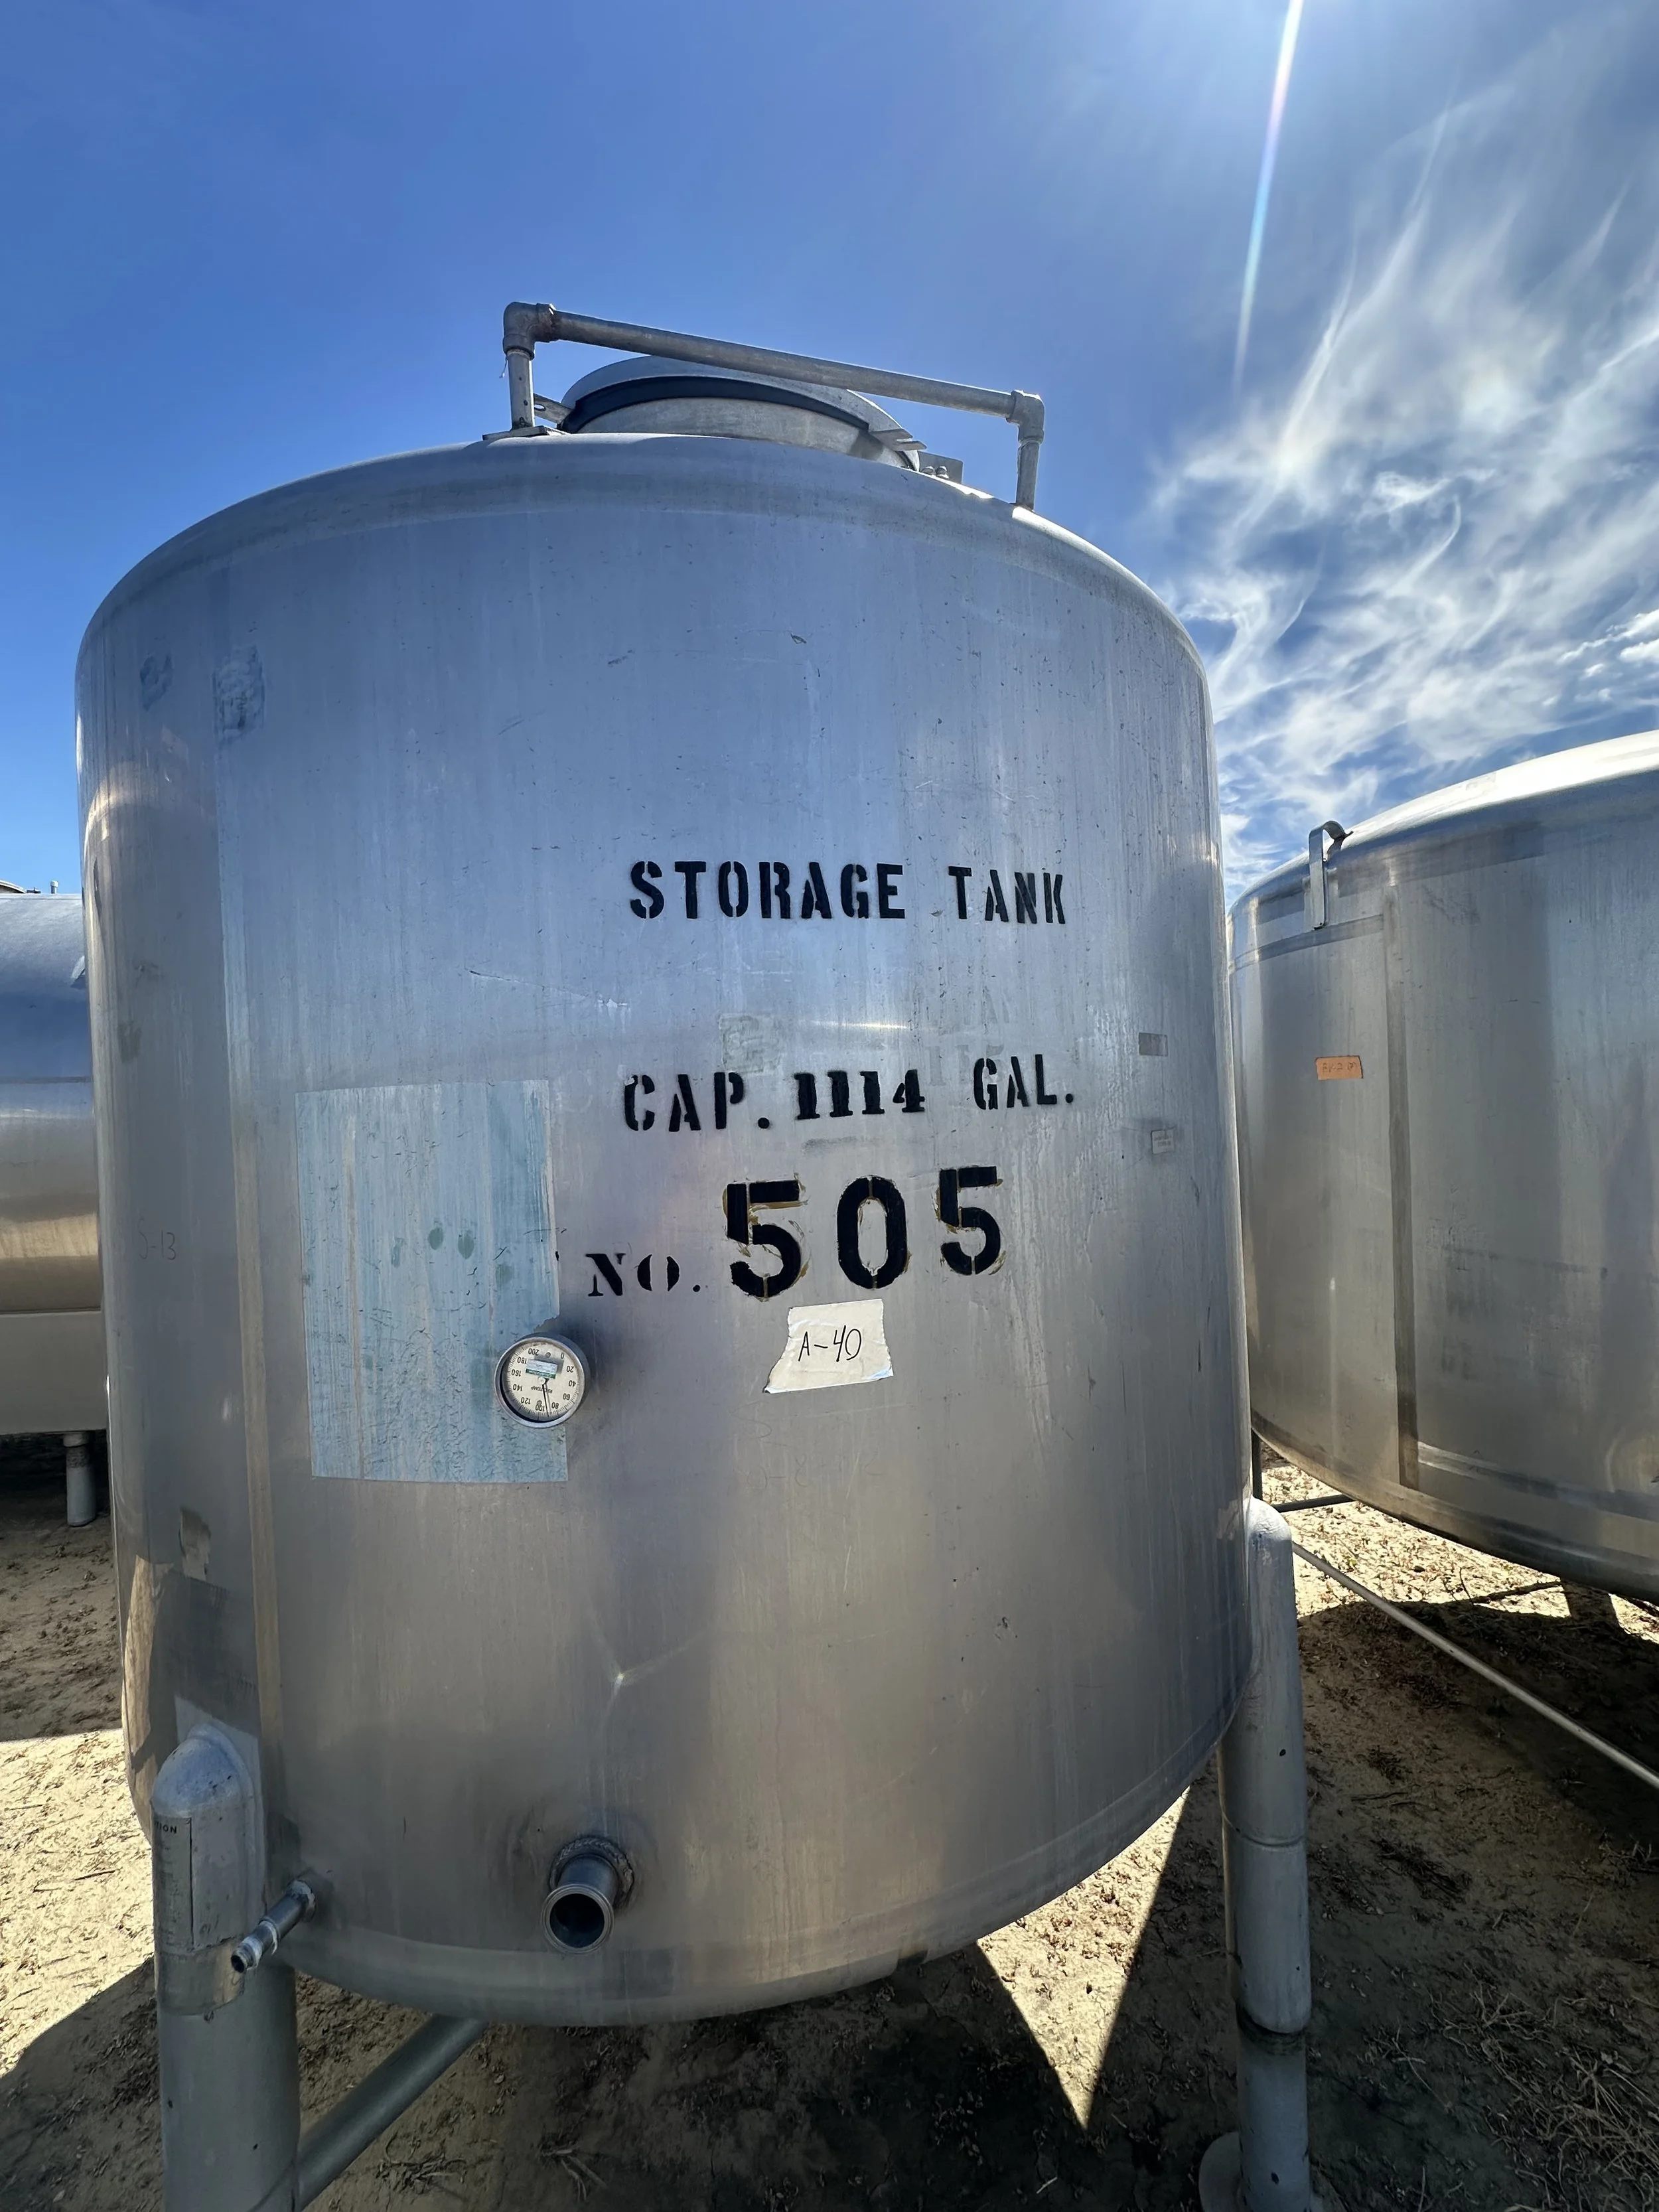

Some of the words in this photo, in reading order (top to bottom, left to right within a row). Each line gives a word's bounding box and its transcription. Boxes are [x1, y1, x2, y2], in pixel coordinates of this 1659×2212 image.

[629, 860, 906, 921] STORAGE
[948, 865, 1066, 924] TANK
[623, 1072, 770, 1132] CAP.
[794, 1069, 926, 1120] 1114
[972, 1054, 1074, 1110] GAL.
[585, 1252, 701, 1297] NO.
[727, 1165, 1001, 1299] 505
[798, 1325, 862, 1363] A-40
